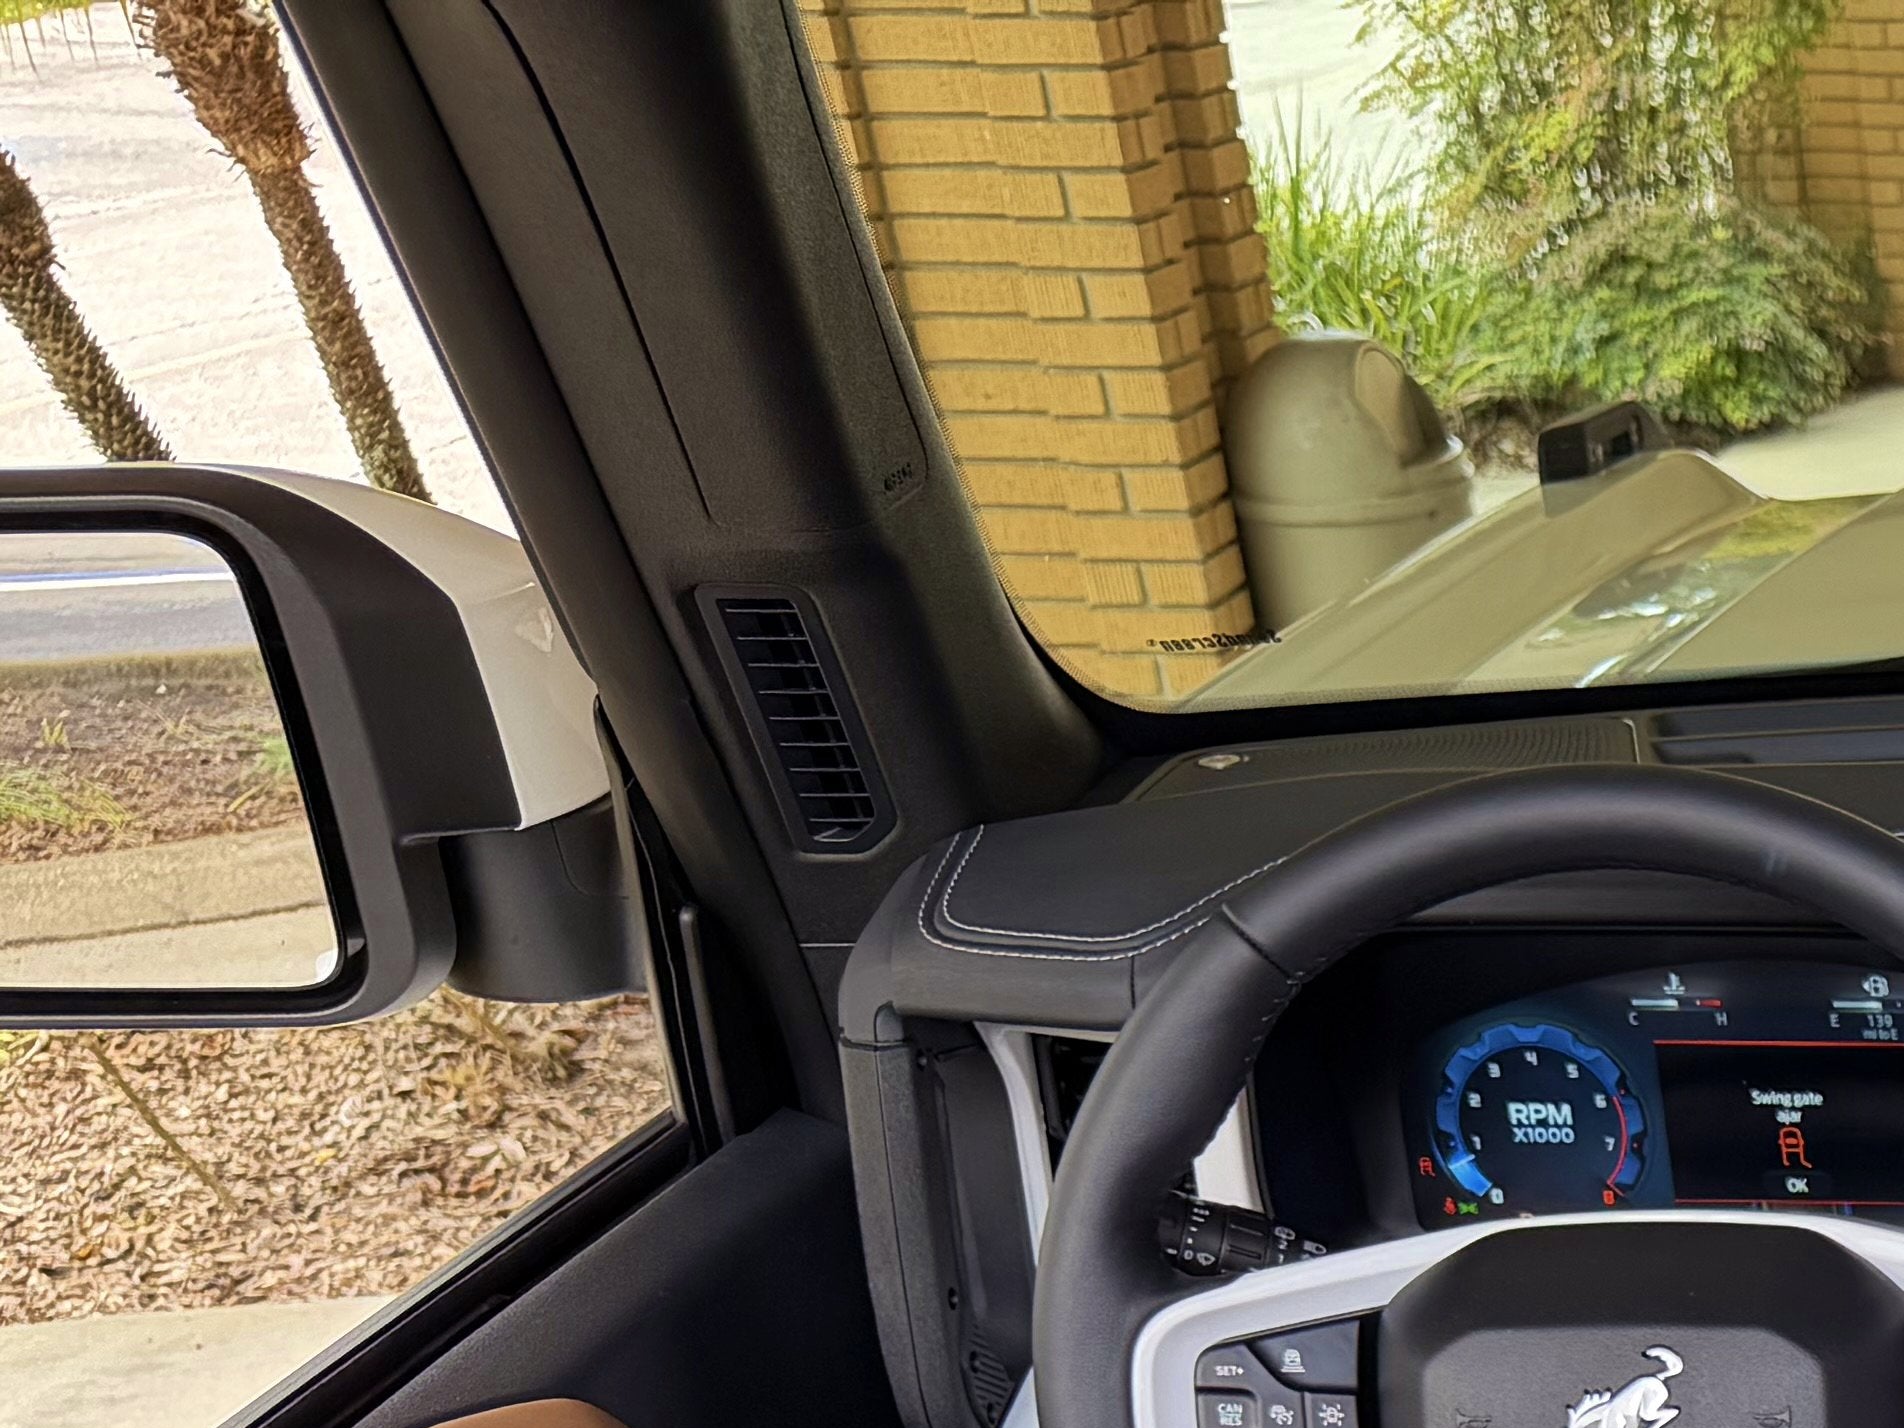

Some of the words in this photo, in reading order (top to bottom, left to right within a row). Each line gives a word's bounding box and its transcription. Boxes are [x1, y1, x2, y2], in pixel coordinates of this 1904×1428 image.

[1628, 1012, 1639, 1026] C
[1714, 1013, 1728, 1027] H
[1829, 1014, 1841, 1028] E
[1867, 1015, 1894, 1029] 139
[1524, 1051, 1538, 1066] 4
[1487, 1062, 1501, 1078] 3
[1566, 1062, 1579, 1079] 5
[1468, 1092, 1482, 1108] 2
[1595, 1093, 1607, 1109] 6
[1751, 1090, 1792, 1108] Swing
[1793, 1091, 1824, 1108] gate
[1508, 1102, 1574, 1126] RPM
[1775, 1110, 1803, 1125] ajar
[1471, 1135, 1482, 1150] 1
[1513, 1127, 1576, 1144] X1000
[1604, 1136, 1615, 1151] 7
[1785, 1176, 1809, 1194] OK
[1490, 1188, 1504, 1204] 0
[1602, 1190, 1616, 1206] 8
